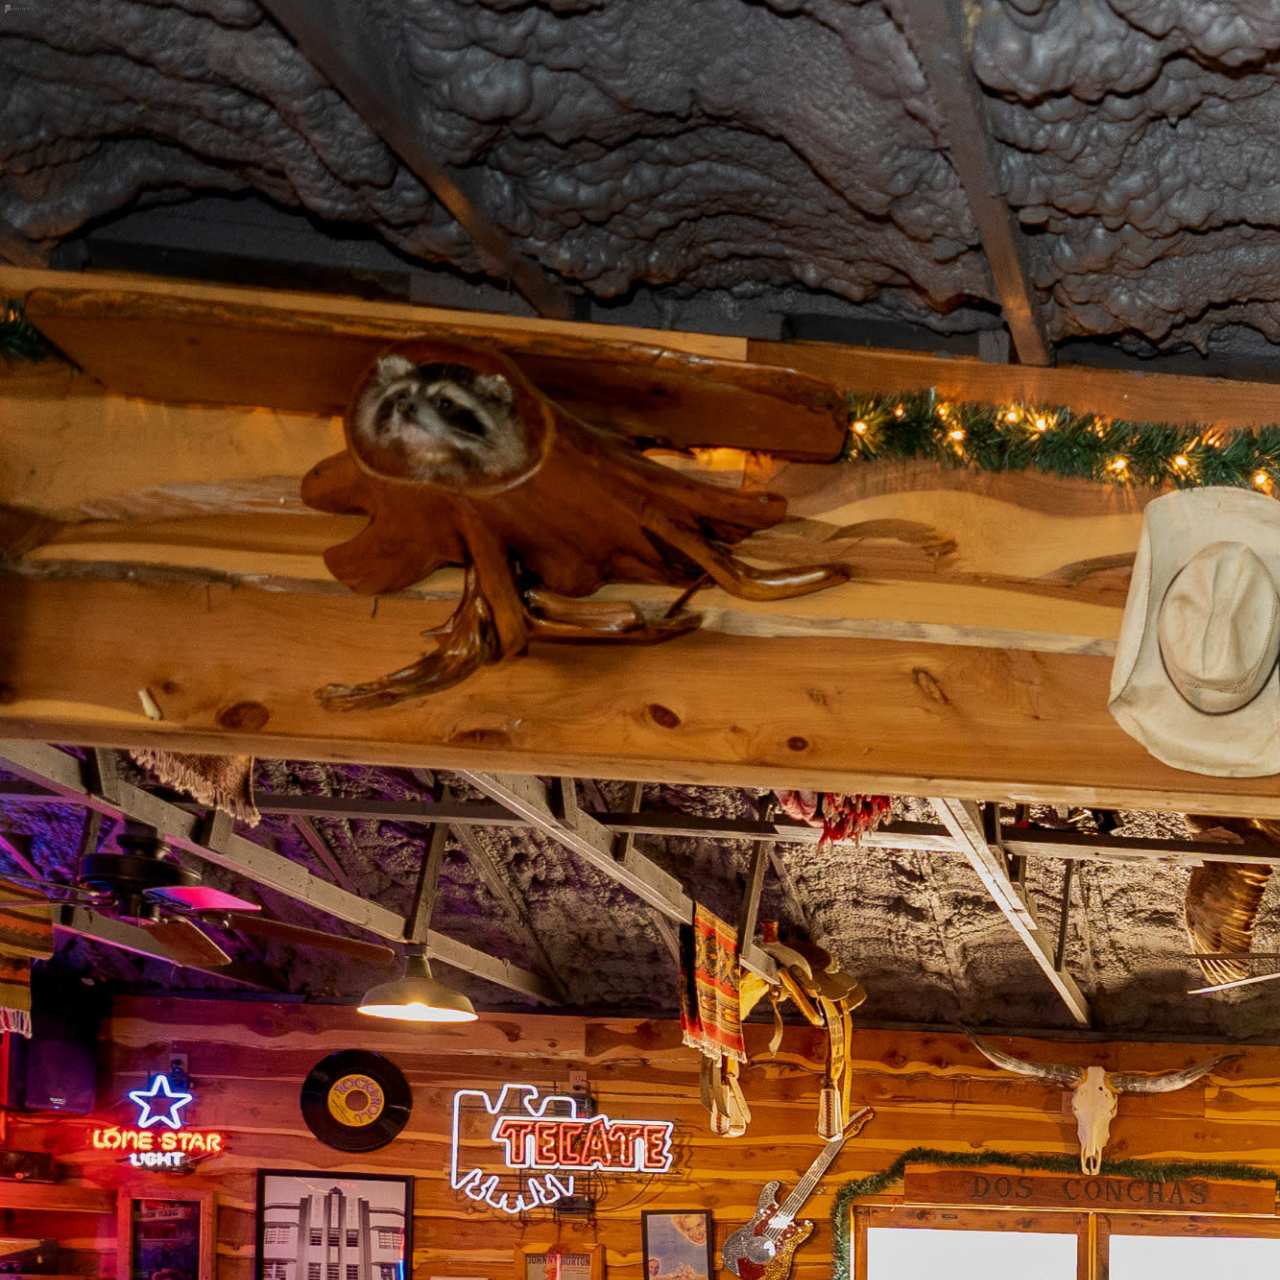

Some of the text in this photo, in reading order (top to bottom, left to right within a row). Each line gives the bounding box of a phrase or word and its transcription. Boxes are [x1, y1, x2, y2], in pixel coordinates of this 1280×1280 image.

[92, 1128, 222, 1152] LONE STAR
[498, 1119, 668, 1168] TECATE
[971, 1176, 1209, 1205] DOS CONCHAS
